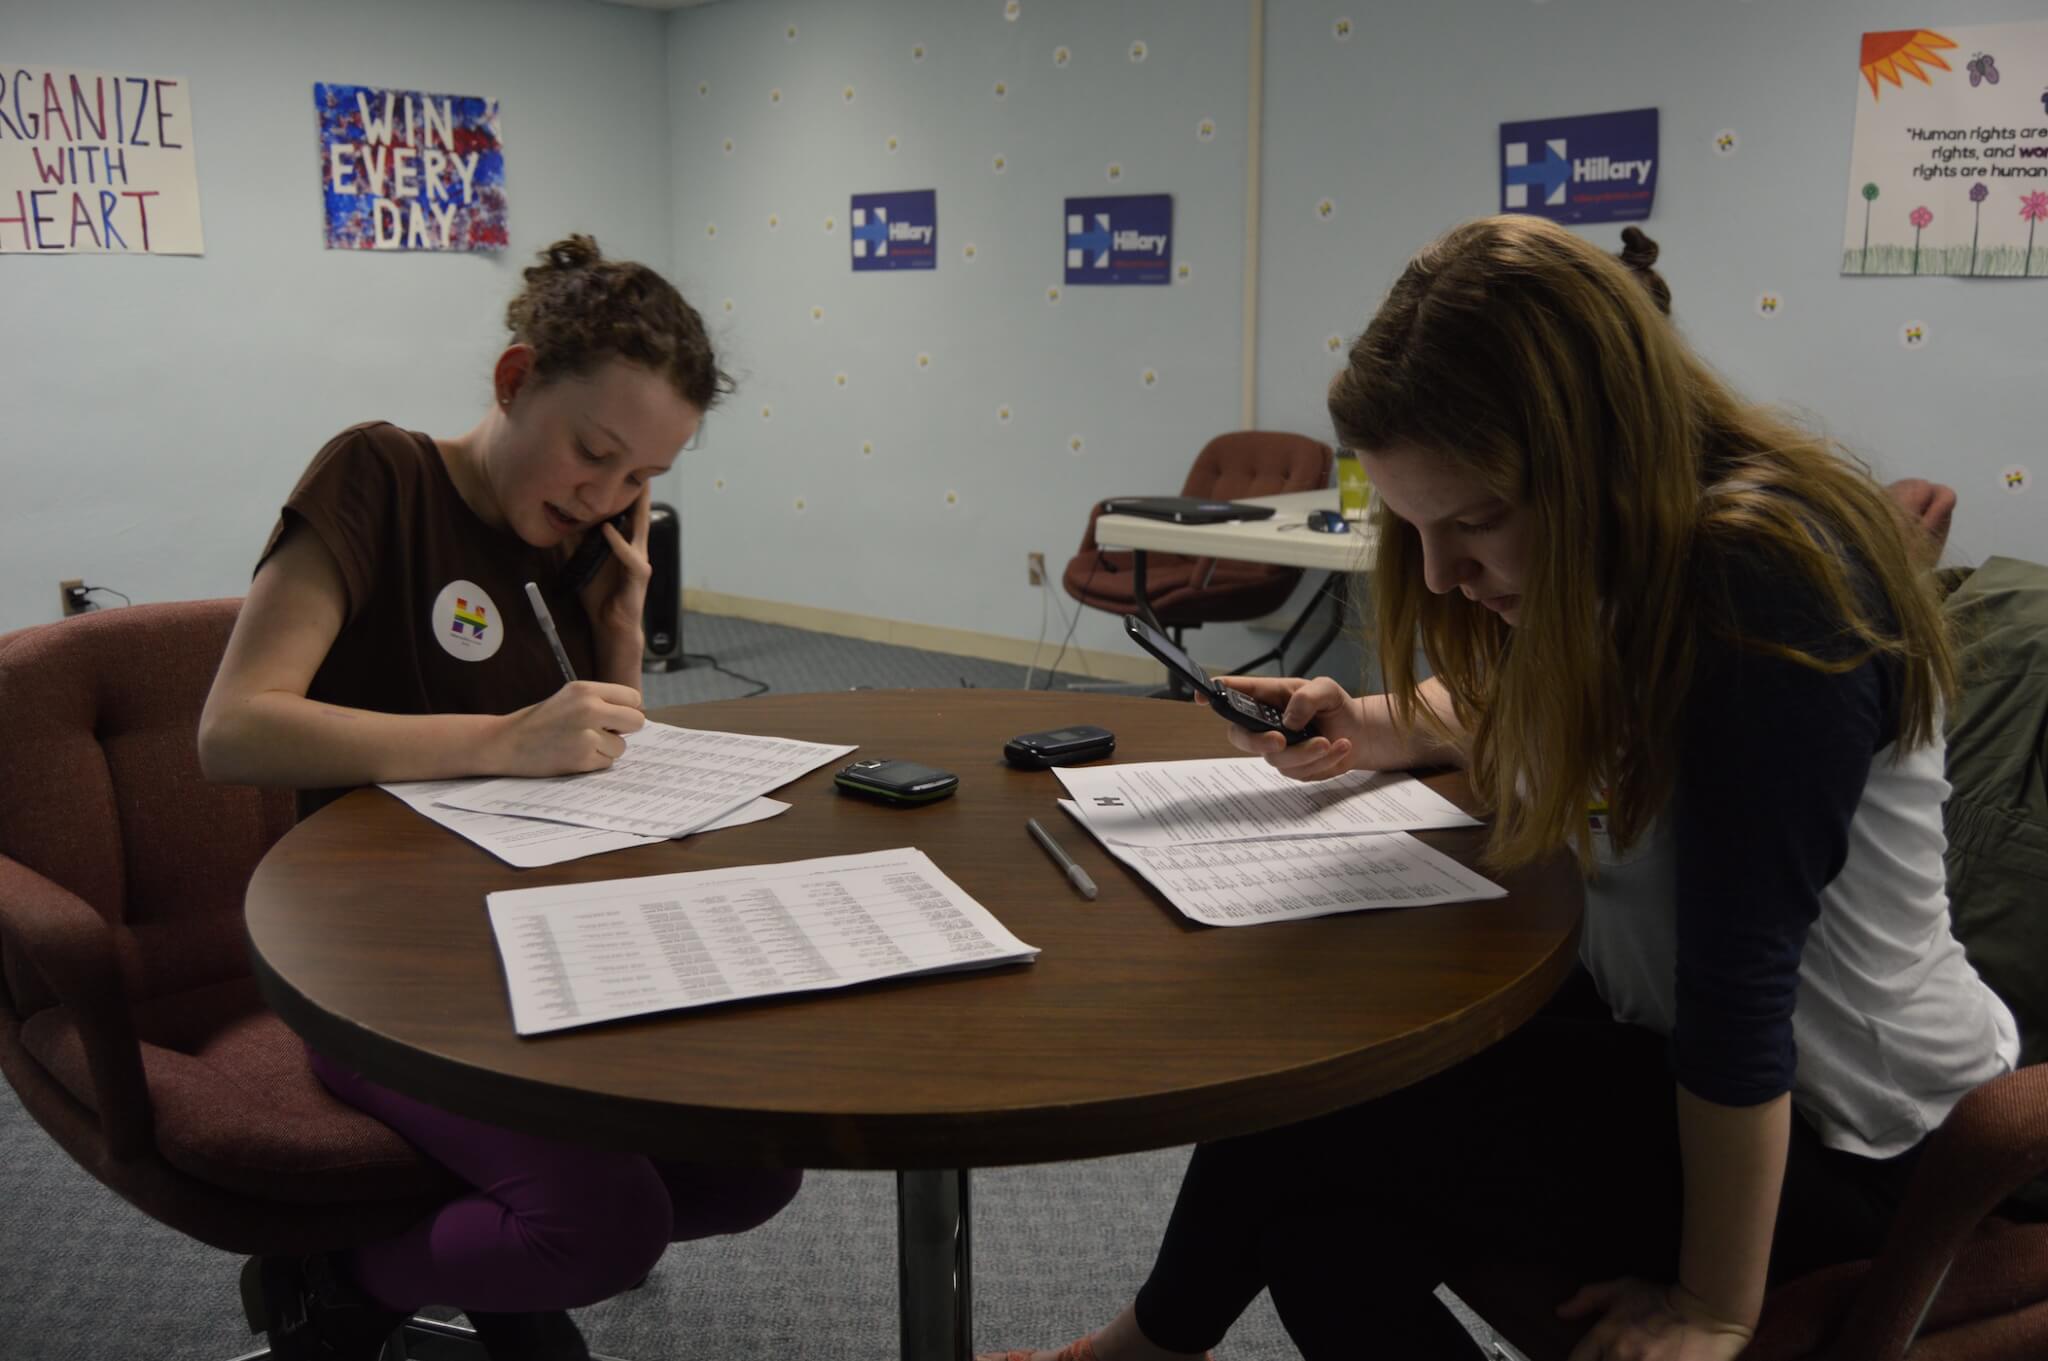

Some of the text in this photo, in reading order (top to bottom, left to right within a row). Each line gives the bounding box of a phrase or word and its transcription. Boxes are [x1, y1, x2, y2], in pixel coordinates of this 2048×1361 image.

[356, 91, 455, 151] WIN
[1970, 126, 2016, 143] rights
[2020, 127, 2048, 139] are
[1983, 144, 2016, 158] and
[32, 146, 128, 186] WITH
[331, 143, 480, 204] EVERY
[1573, 156, 1653, 185] Hillary
[1912, 162, 2048, 181] rights are human
[0, 189, 160, 252] HEART
[373, 198, 458, 249] DAY
[889, 222, 933, 245] Hillary
[1113, 230, 1168, 256] Hillary
